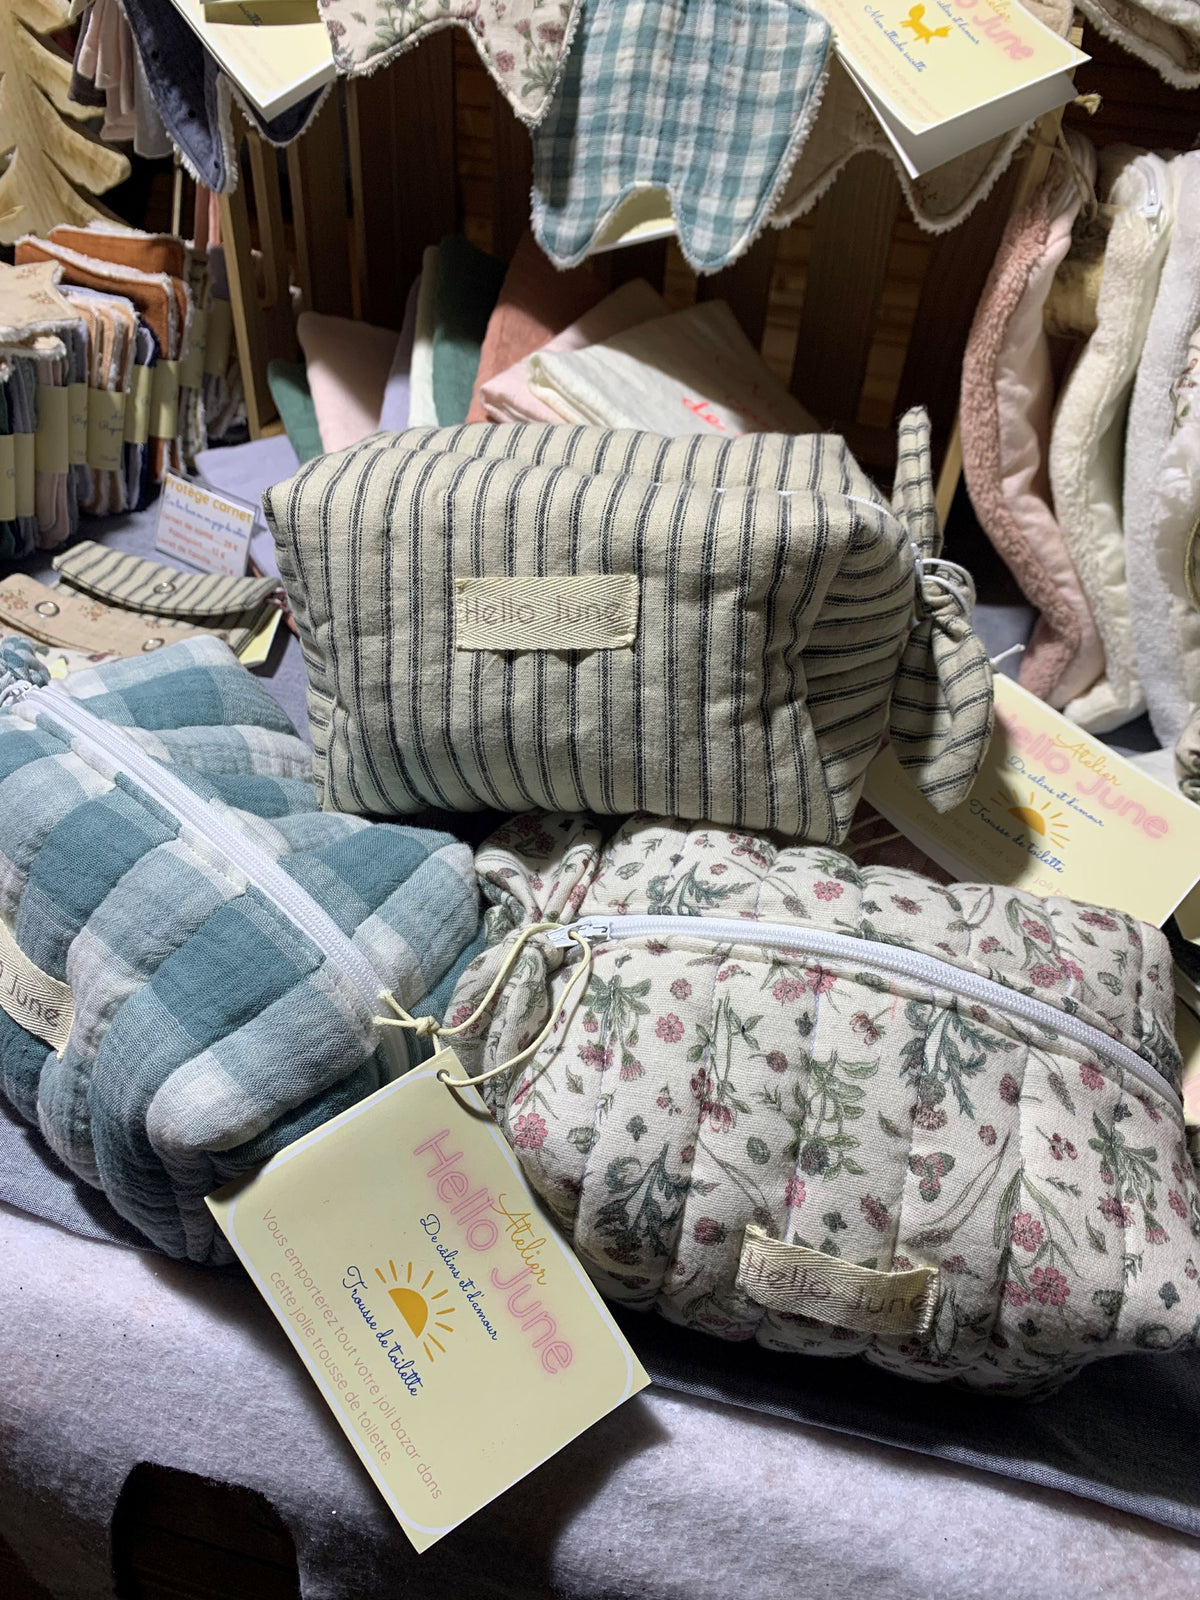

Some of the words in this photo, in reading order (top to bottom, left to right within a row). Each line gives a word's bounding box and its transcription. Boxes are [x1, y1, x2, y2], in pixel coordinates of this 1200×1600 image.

[972, 15, 1035, 61] June
[212, 499, 253, 523] carnet
[464, 597, 536, 626] Hello
[993, 703, 1070, 775] ello
[1075, 775, 1169, 839] June
[1006, 755, 1027, 776] De
[1056, 791, 1068, 802] et
[1052, 733, 1121, 786] Atelier
[969, 799, 1011, 839] Trousse
[1012, 834, 1027, 848] de
[1027, 842, 1066, 874] toilette
[8, 973, 60, 1028] June
[413, 1129, 499, 1251] Hello
[490, 1266, 574, 1374] June
[419, 1213, 441, 1243] De
[487, 1193, 547, 1286] Atelier
[436, 1243, 461, 1281] câlins
[458, 1277, 476, 1293] et
[466, 1292, 498, 1341] d'amour
[854, 1285, 929, 1315] June
[262, 1208, 288, 1248] Vous
[284, 1246, 340, 1328] emporterez
[333, 1325, 358, 1360] tout
[353, 1356, 381, 1396] votre
[371, 1392, 398, 1421] joli
[390, 1416, 422, 1462] bazar
[416, 1461, 444, 1501] dans
[269, 1271, 297, 1307] cette
[312, 1337, 349, 1390] trousse
[344, 1388, 361, 1412] de
[342, 1265, 378, 1330] Trousse
[375, 1328, 394, 1349] de
[387, 1341, 424, 1397] toilette
